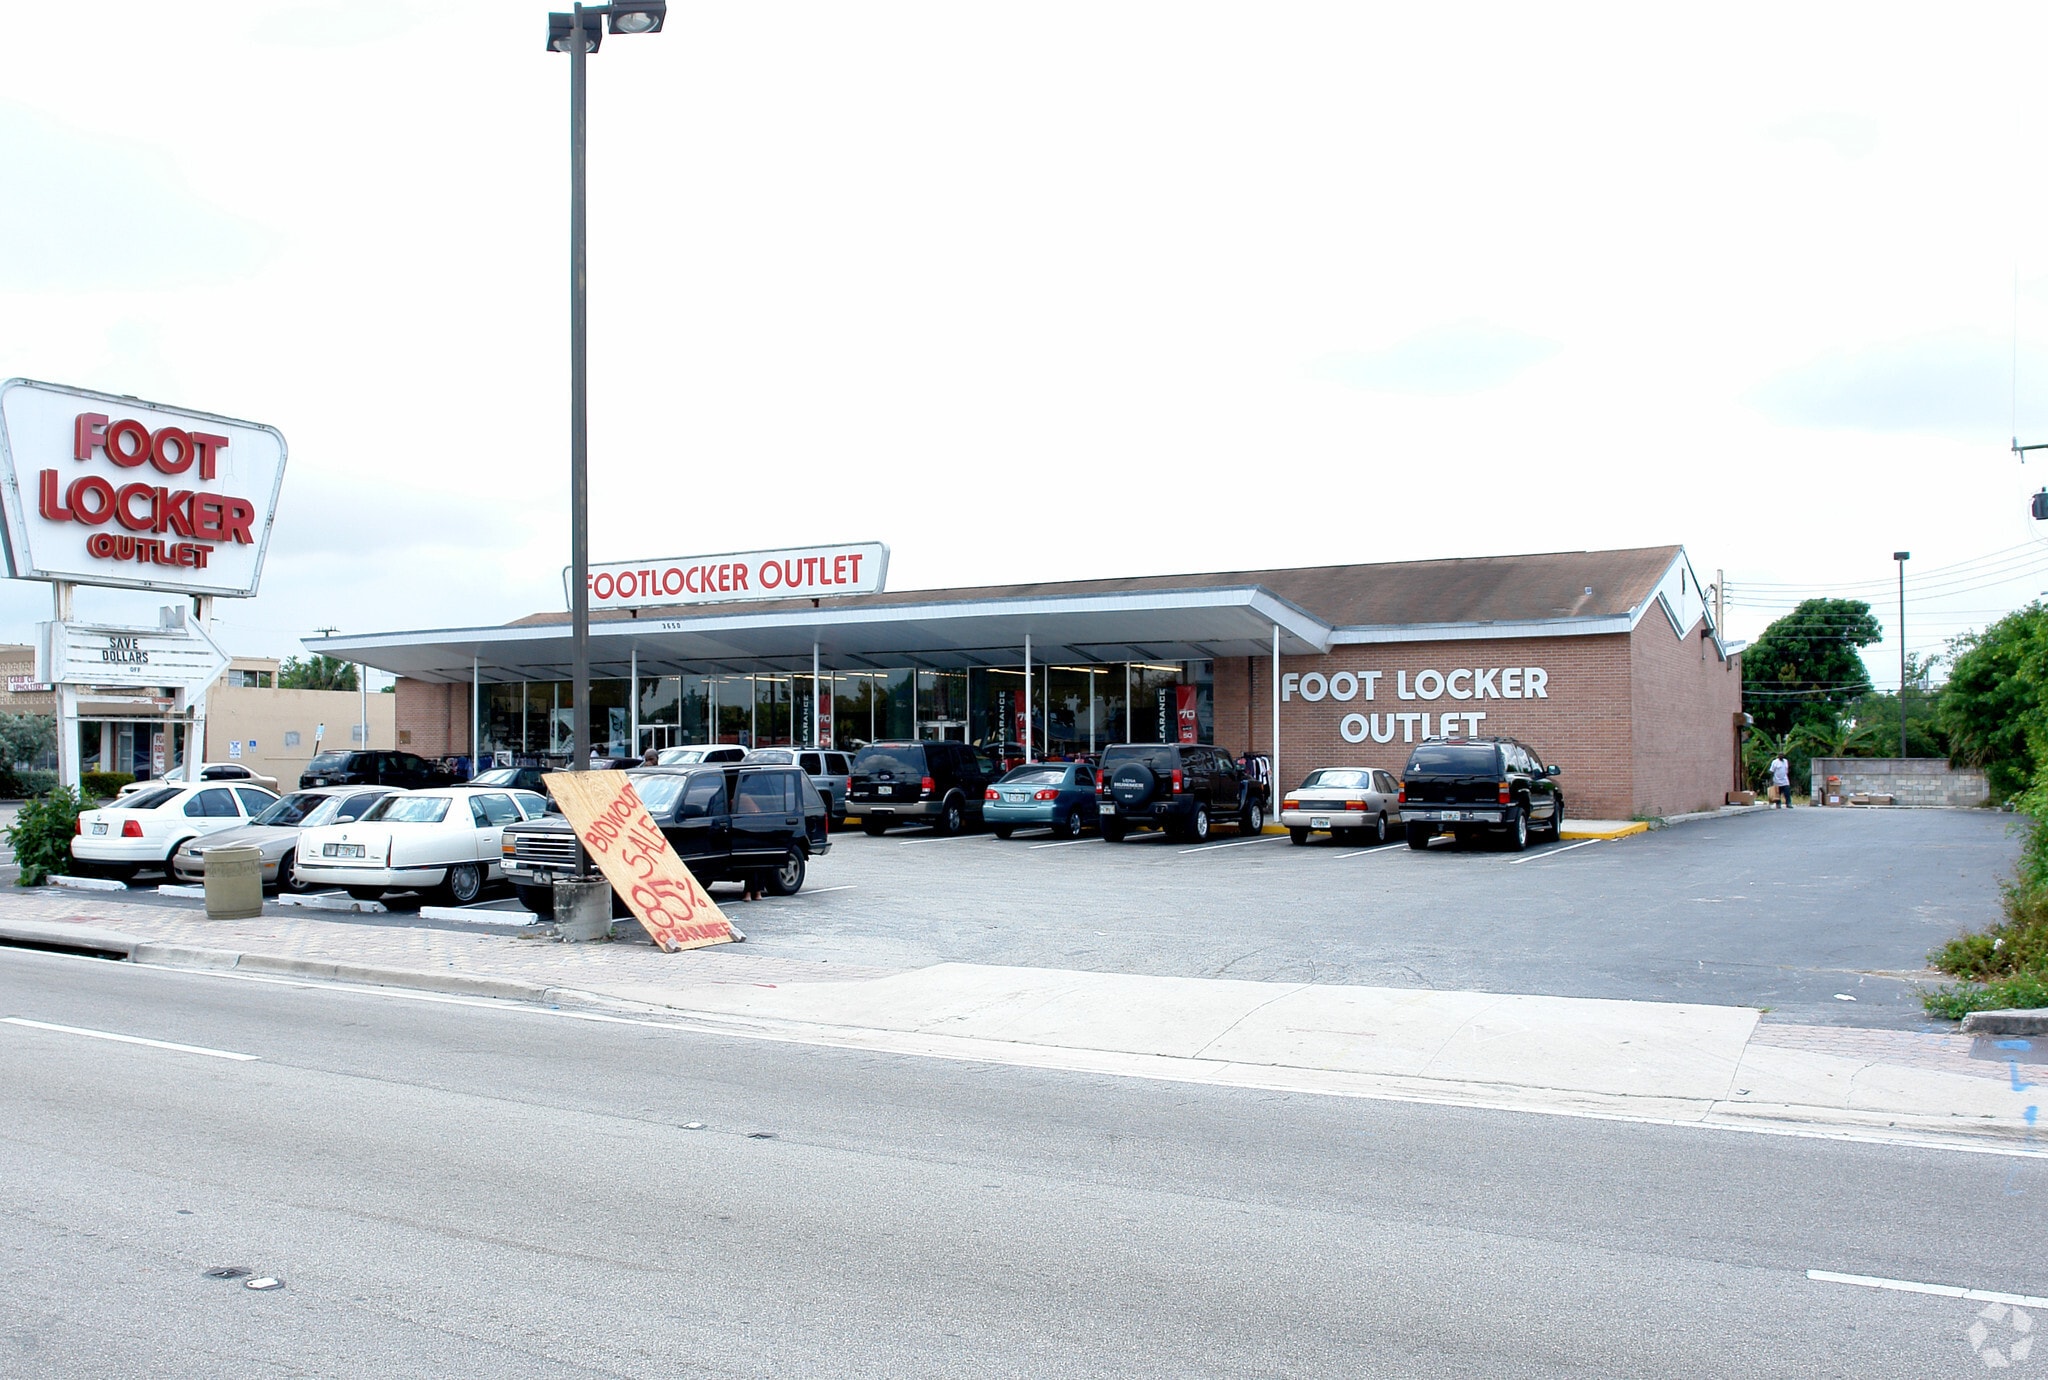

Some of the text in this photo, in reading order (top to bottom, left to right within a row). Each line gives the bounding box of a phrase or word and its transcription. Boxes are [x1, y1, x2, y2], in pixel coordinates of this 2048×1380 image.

[74, 412, 229, 480] FOOT
[39, 468, 255, 544] LOCKER
[87, 533, 214, 568] OUTLET
[759, 554, 862, 589] OUTLET
[102, 650, 149, 663] DOLLARS
[110, 637, 138, 649] SAVE
[1282, 668, 1548, 701] FOOT LOCKER
[998, 691, 1006, 756] CLEARANCE
[1179, 709, 1195, 720] 70
[1340, 711, 1487, 744] OUTLET
[622, 815, 666, 878] SALE
[632, 877, 707, 928] 85%
